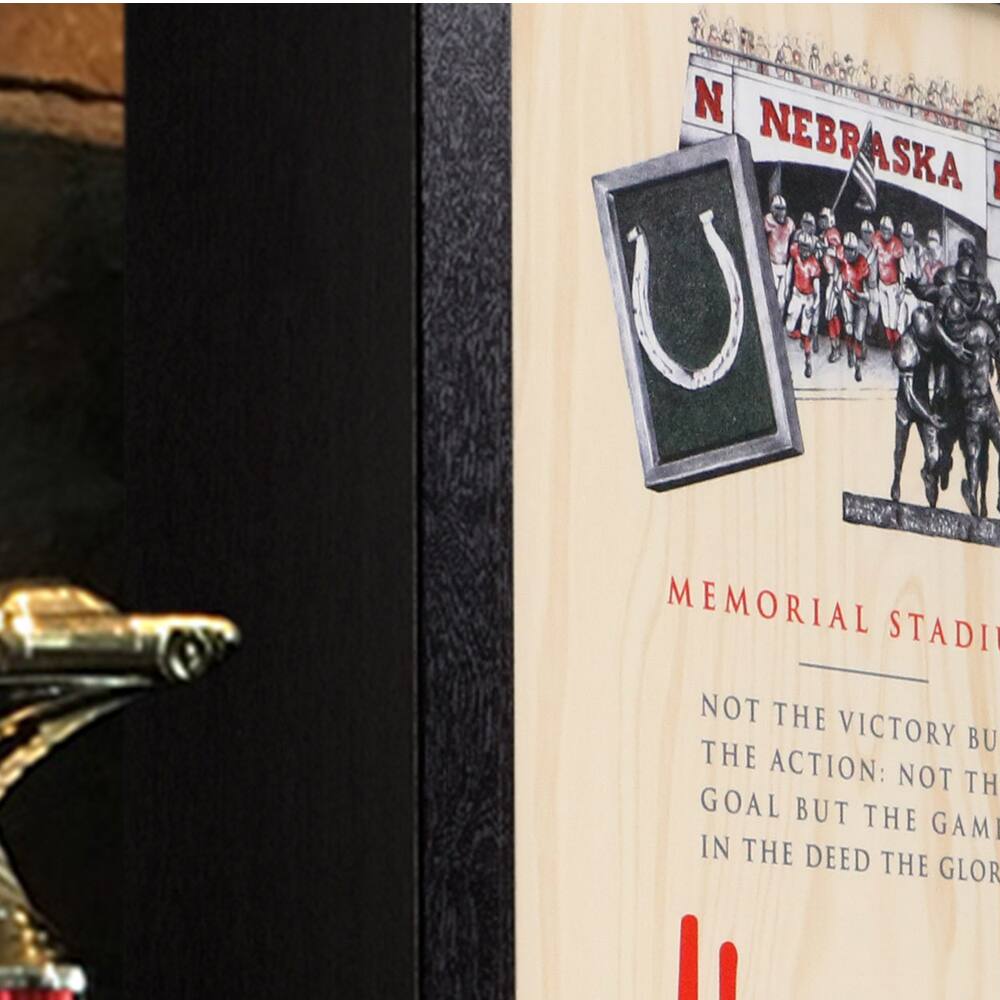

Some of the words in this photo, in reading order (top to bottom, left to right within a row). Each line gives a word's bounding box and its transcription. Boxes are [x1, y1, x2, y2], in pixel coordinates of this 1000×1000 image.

[694, 75, 725, 124] N
[759, 96, 963, 191] NEBRASKA
[667, 575, 869, 635] MEMORIAL
[701, 692, 760, 724] NOT
[773, 700, 827, 732] THE
[838, 709, 957, 748] VICTORY
[701, 739, 757, 770] THE
[769, 747, 886, 784] ACTION:
[898, 763, 953, 792] NOT
[700, 786, 781, 819] GOAL
[795, 796, 849, 826] BUT
[863, 803, 917, 833] THE
[700, 833, 730, 860] IN
[742, 837, 794, 867] THE
[805, 843, 871, 873] DEED
[880, 850, 929, 878] THE
